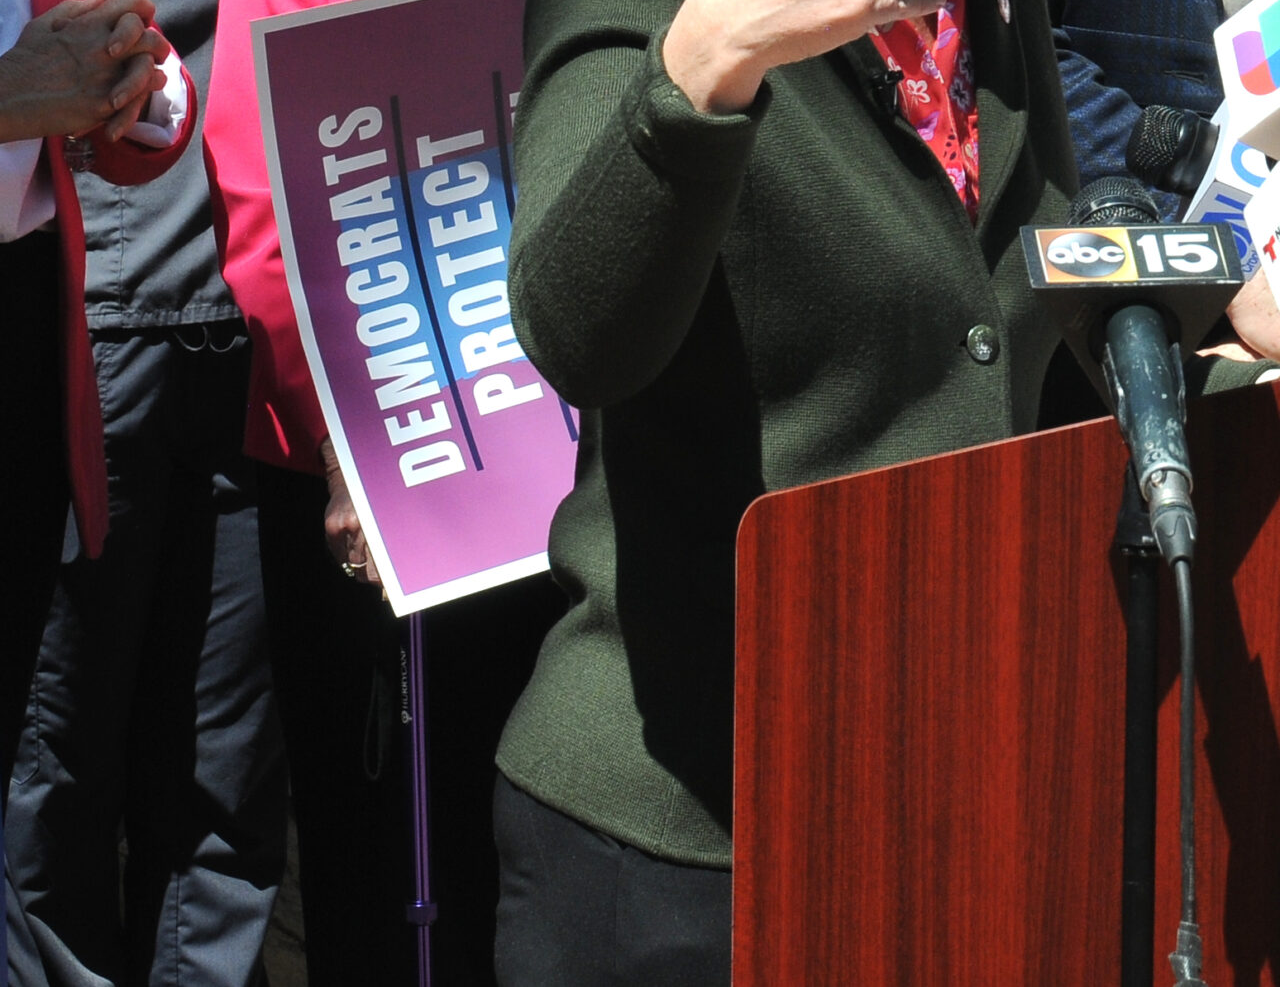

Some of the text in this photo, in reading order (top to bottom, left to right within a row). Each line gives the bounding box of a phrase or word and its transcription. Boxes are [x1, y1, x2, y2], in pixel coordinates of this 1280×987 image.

[318, 104, 466, 488] DEMOCRATS
[416, 123, 543, 416] PROTECT
[1046, 233, 1218, 273] abc 15
